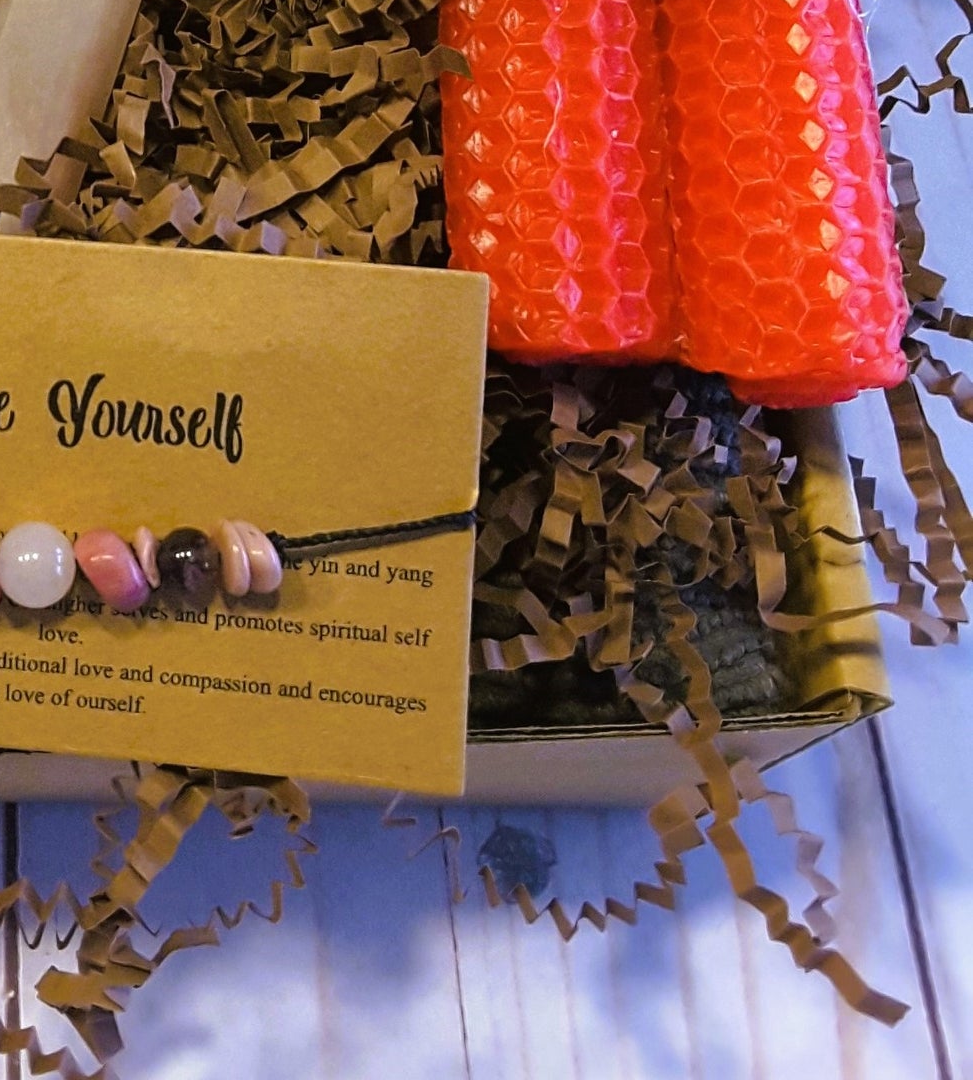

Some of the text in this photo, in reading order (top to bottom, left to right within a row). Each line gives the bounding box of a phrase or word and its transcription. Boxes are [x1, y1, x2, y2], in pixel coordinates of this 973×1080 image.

[48, 373, 243, 464] Yourself
[346, 559, 380, 579] and
[386, 565, 434, 588] yang
[38, 623, 84, 646] love.
[176, 606, 208, 625] and
[214, 611, 304, 635] promotes
[309, 618, 388, 644] spiritual
[394, 629, 434, 648] self
[6, 683, 45, 705] love
[51, 688, 74, 707] of
[74, 658, 114, 679] love
[119, 664, 154, 685] and
[159, 669, 272, 696] compassion
[278, 680, 313, 700] and
[318, 685, 428, 714] encourages
